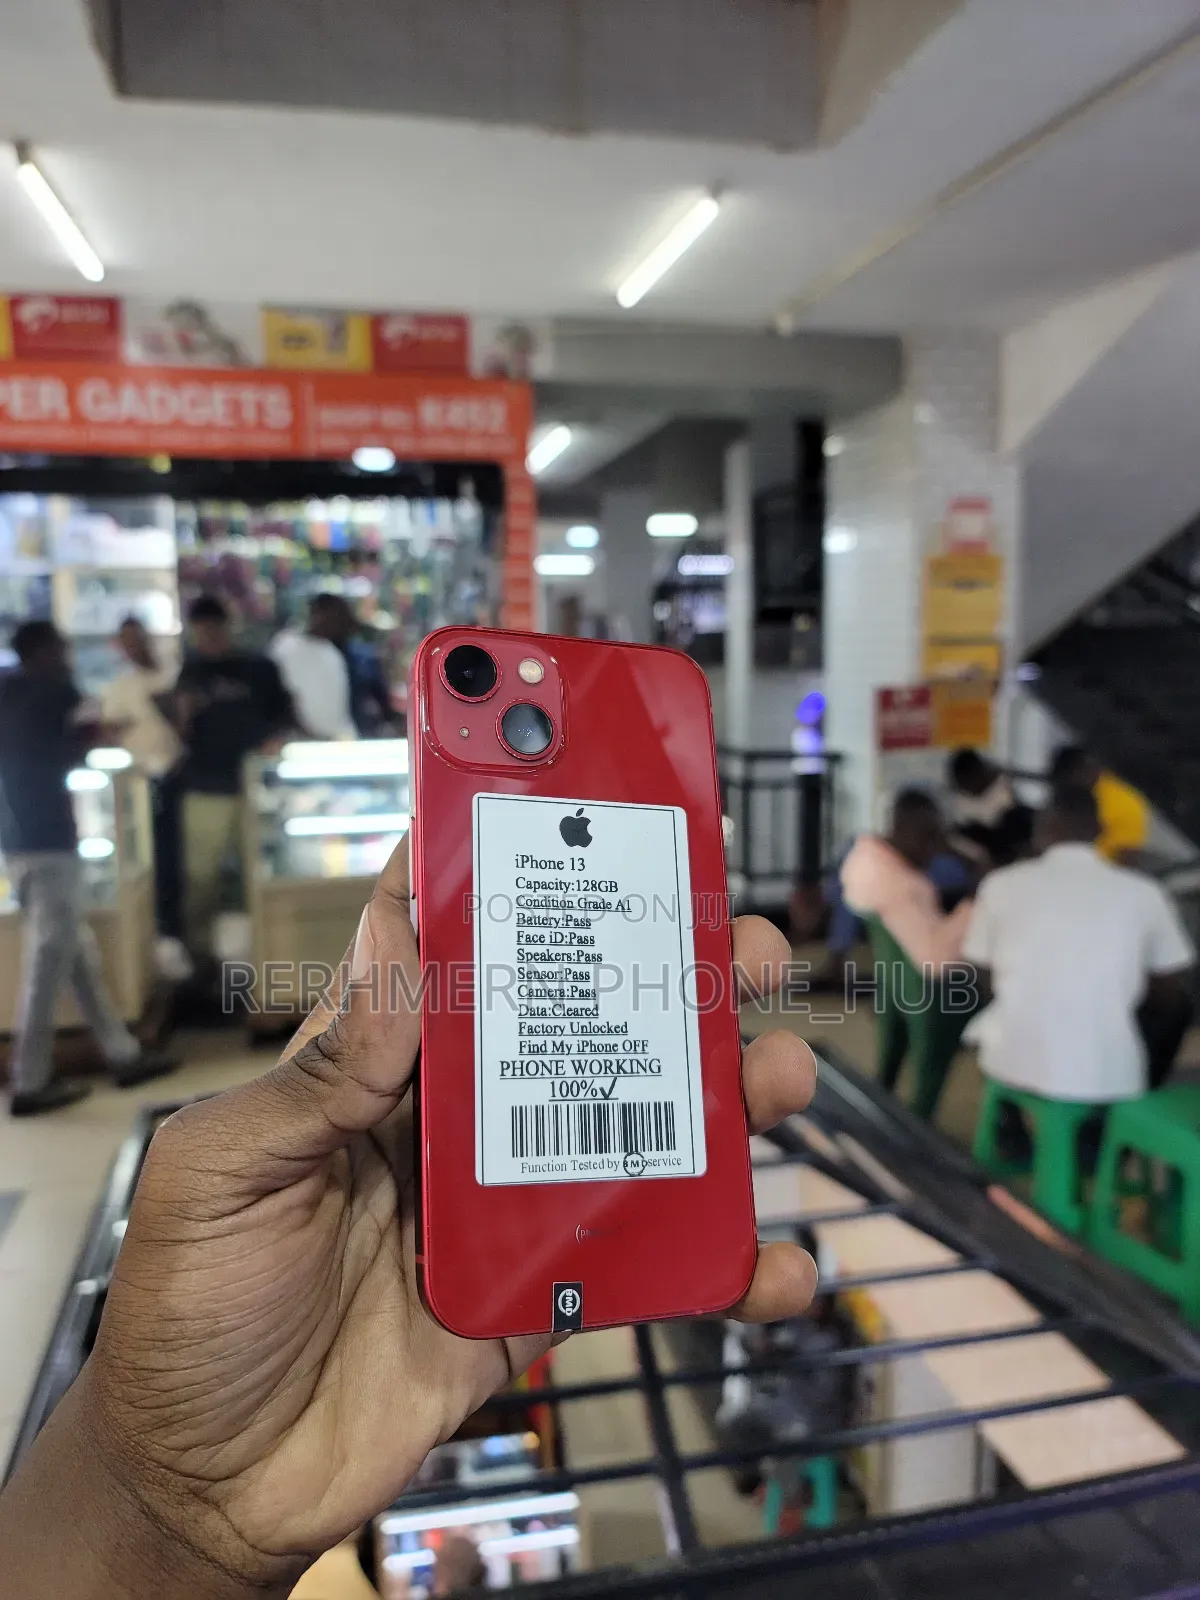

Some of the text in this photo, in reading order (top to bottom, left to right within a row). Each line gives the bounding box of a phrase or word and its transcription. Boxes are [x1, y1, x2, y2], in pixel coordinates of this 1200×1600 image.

[78, 377, 292, 428] GADGETS
[515, 854, 586, 871] iPhone 13
[515, 877, 619, 893] Capacity:128GB
[516, 895, 574, 910] Condition
[577, 897, 613, 911] Grade
[516, 913, 592, 929] Battery:Pass
[516, 930, 596, 945] Face iD:Pass
[517, 949, 603, 964] Speakers:Pass
[517, 967, 591, 981] Sensor:Pass
[517, 984, 597, 999] Camera:Pass
[518, 1004, 600, 1018] Data:Cleared
[518, 1021, 629, 1037] Factory Unlocked
[518, 1039, 650, 1055] Find My iPhone OFF
[499, 1058, 662, 1077] PHONE WORKING
[549, 1079, 598, 1099] 100%
[520, 1162, 567, 1174] Function
[570, 1159, 605, 1172] Tested
[607, 1158, 620, 1172] by
[565, 1288, 574, 1317] BMD
